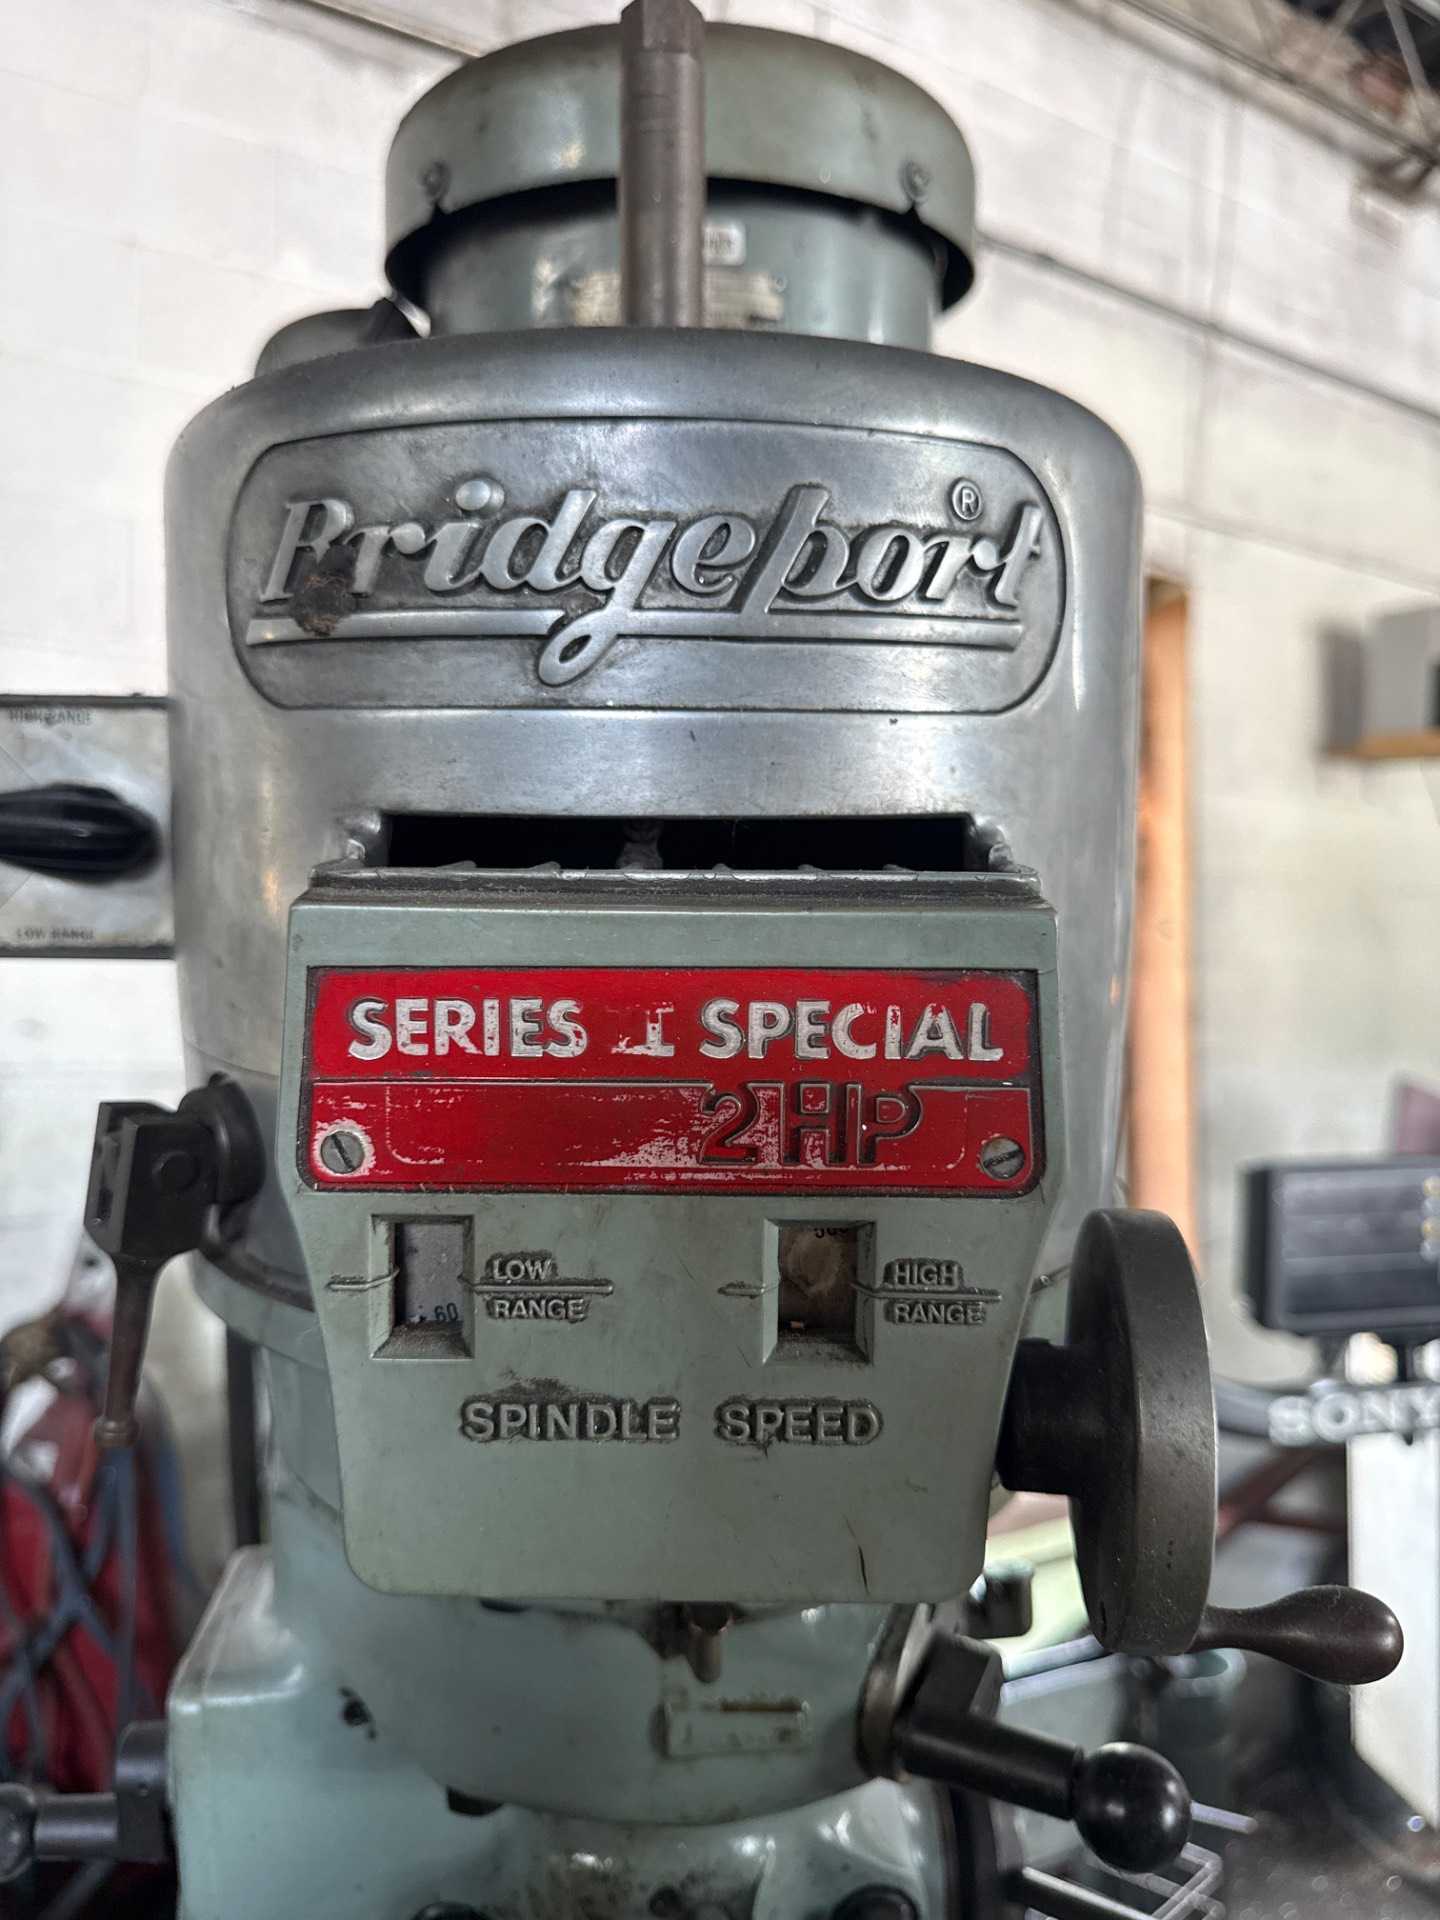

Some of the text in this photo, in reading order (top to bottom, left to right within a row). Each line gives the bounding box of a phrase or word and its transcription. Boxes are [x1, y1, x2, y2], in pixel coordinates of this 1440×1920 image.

[257, 482, 1044, 687] Bridgeport
[346, 997, 587, 1060] SERIES
[699, 998, 1005, 1062] SPECIAL
[491, 1258, 554, 1281] LOW
[894, 1262, 960, 1288] HIGH
[494, 1299, 586, 1320] RANGE
[895, 1303, 985, 1324] RANGE
[462, 1401, 881, 1444] SPINDLE SPEED
